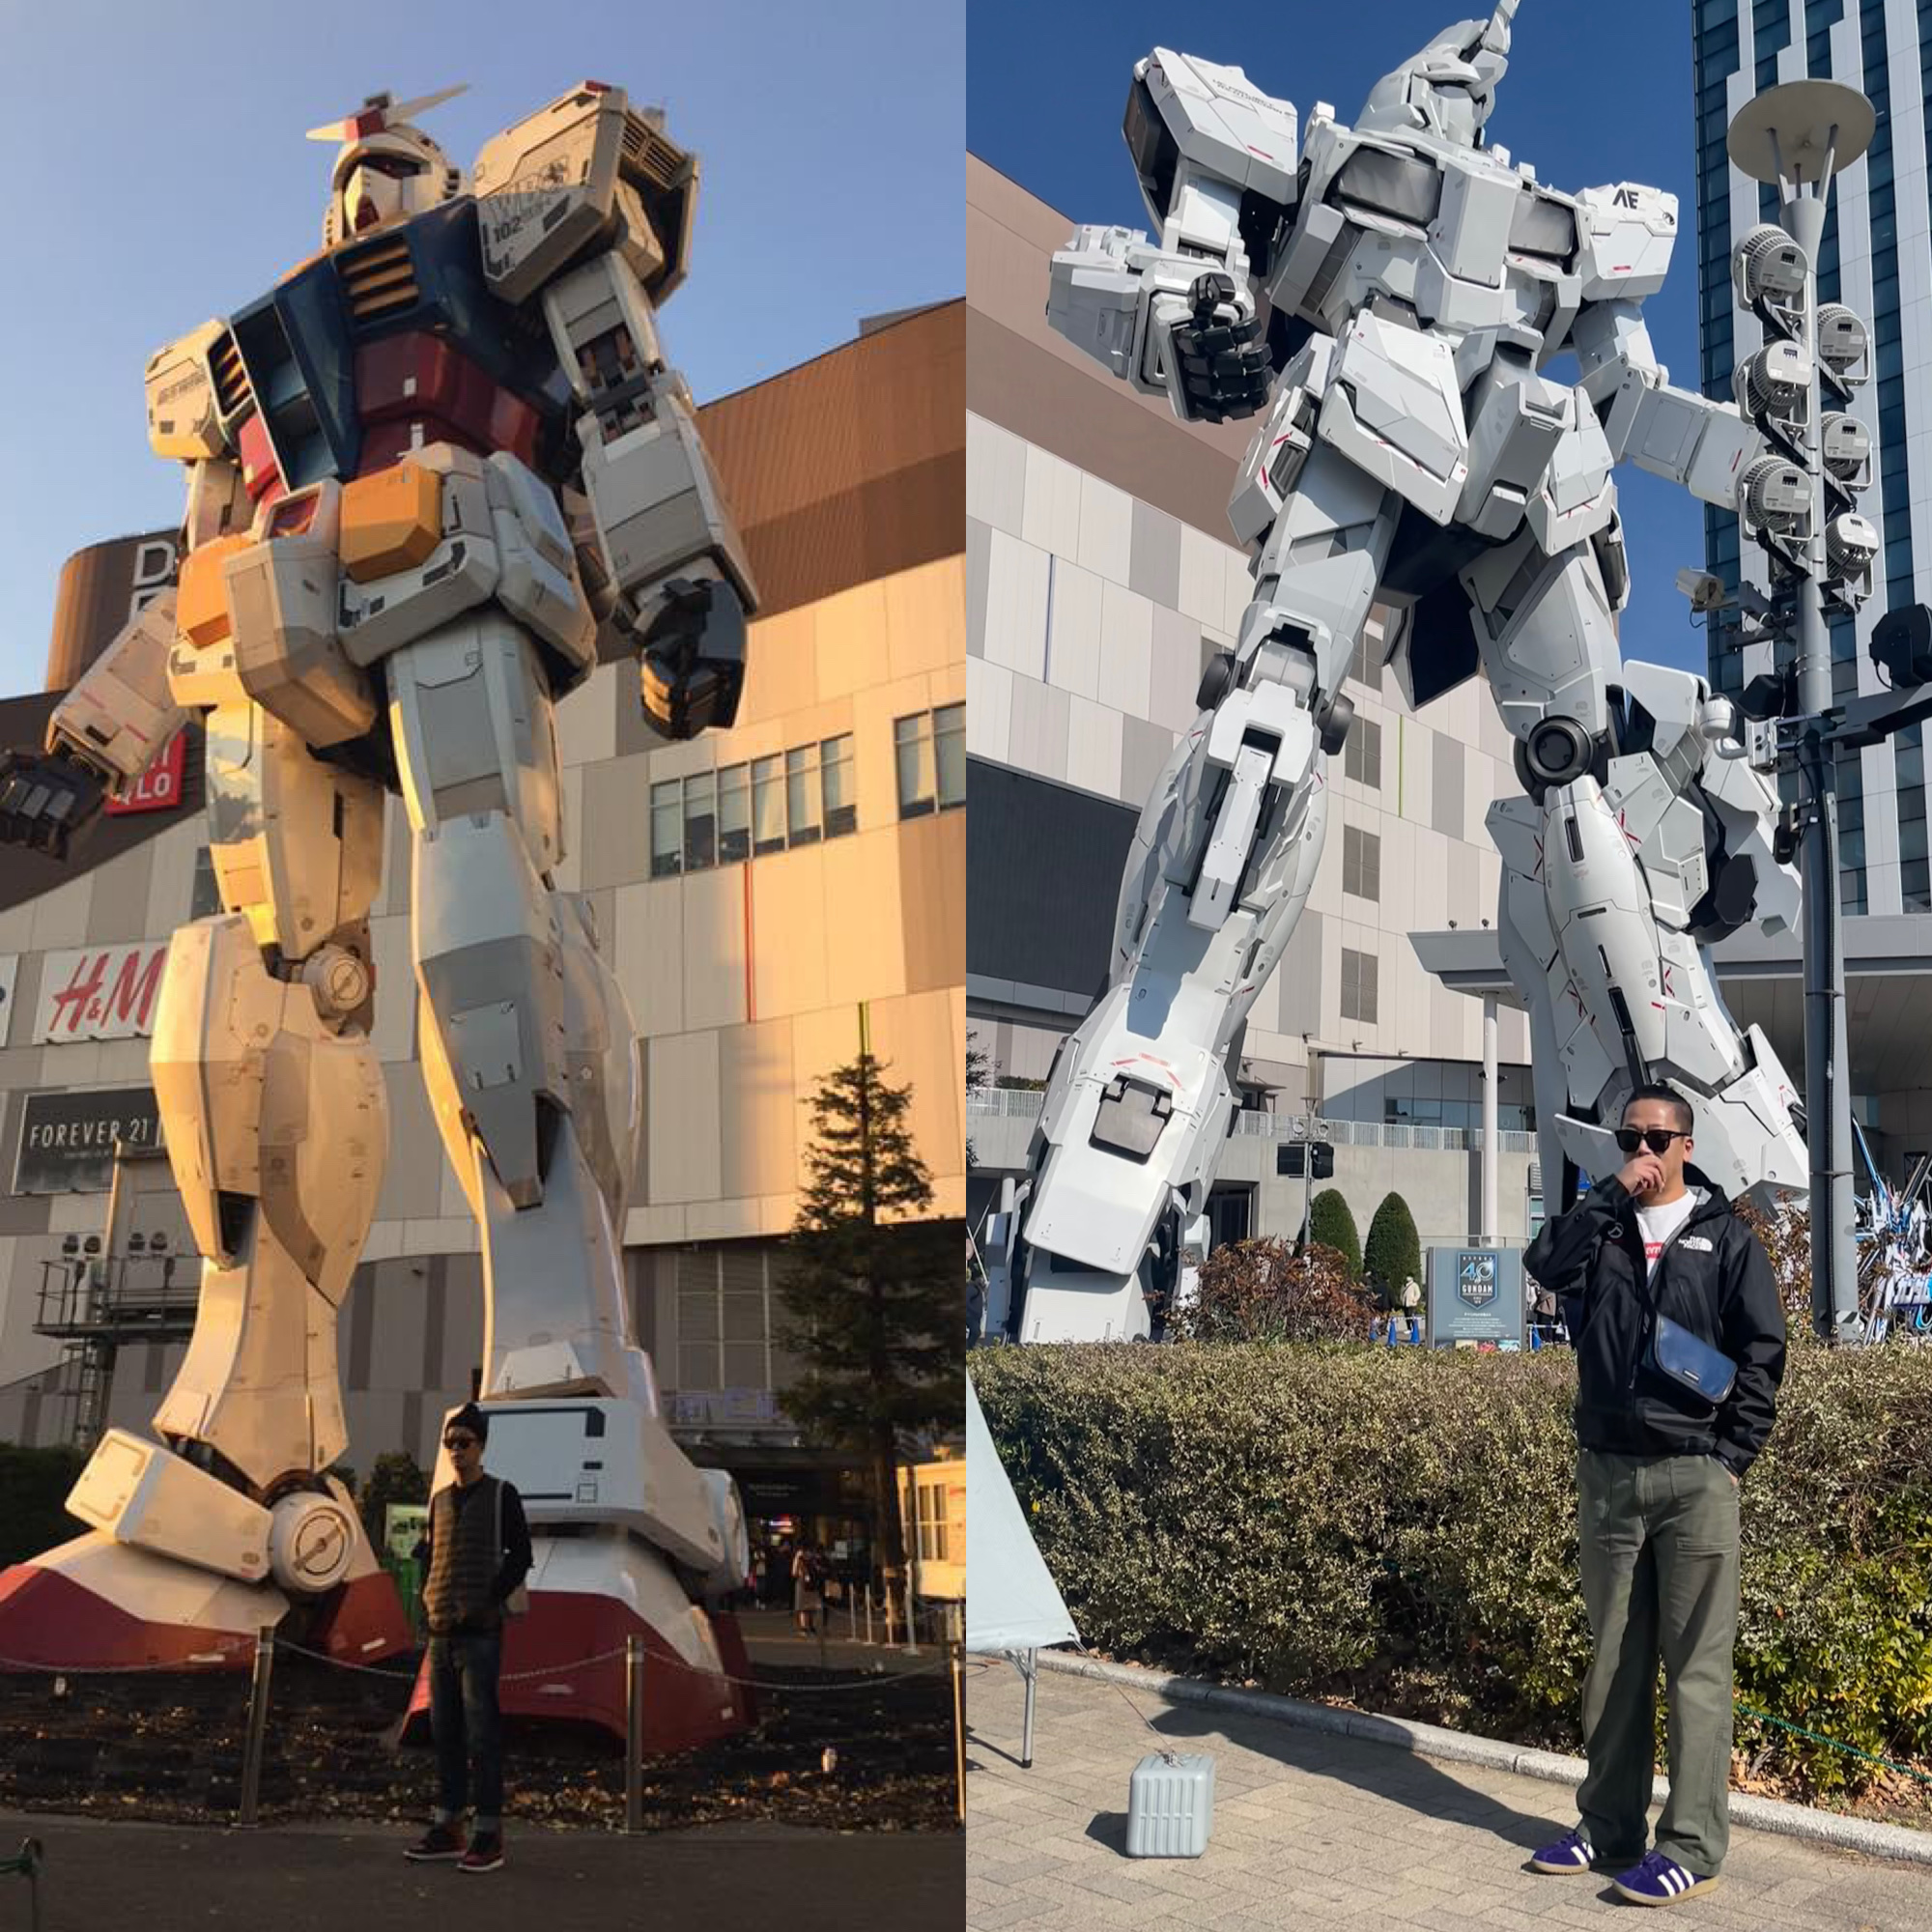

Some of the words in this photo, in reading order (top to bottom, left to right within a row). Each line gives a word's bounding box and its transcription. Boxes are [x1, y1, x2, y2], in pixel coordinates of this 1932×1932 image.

[493, 215, 524, 243] 102
[133, 541, 176, 586] D
[50, 947, 166, 1033] H&M
[29, 1120, 120, 1149] FOREVER
[128, 1118, 149, 1143] 21
[1462, 1284, 1493, 1293] GUNDAM
